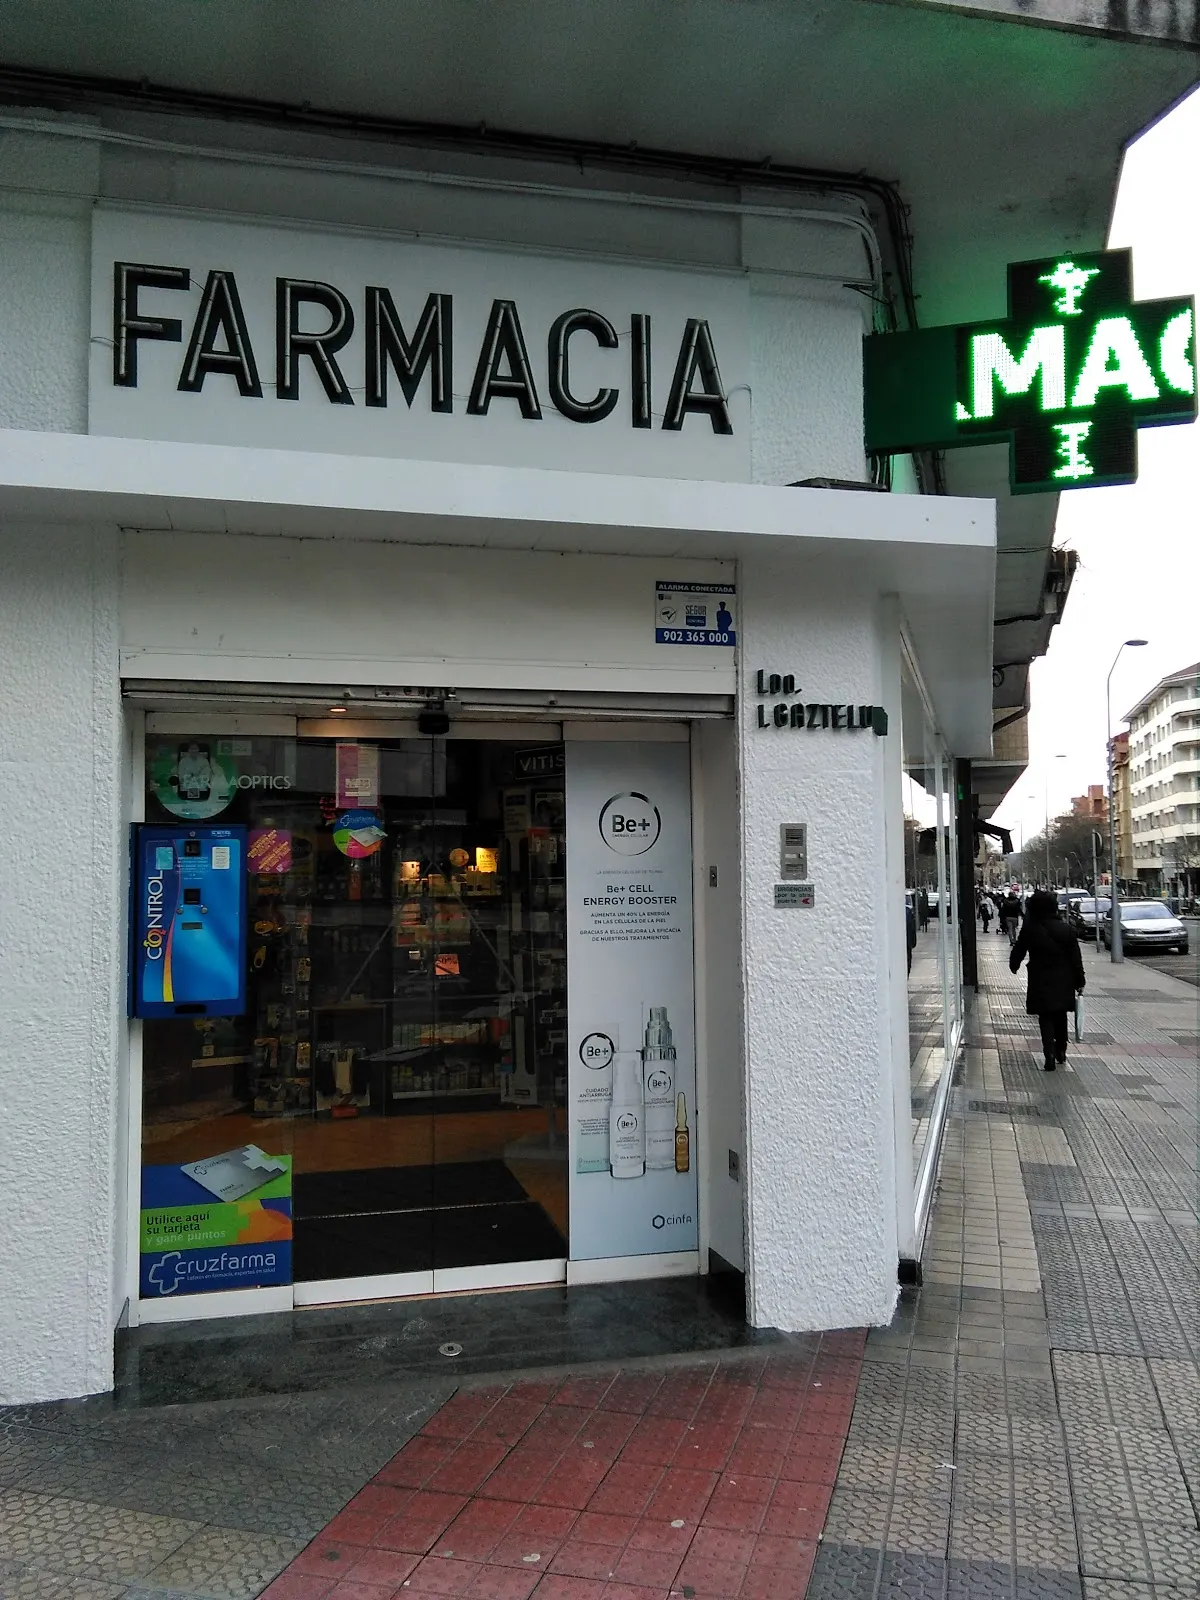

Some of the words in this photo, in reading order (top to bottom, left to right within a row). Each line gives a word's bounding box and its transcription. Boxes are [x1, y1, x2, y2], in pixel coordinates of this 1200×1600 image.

[113, 260, 734, 436] FARMACIA
[690, 585, 733, 593] CONECTADA
[685, 604, 707, 615] SEGUR
[663, 630, 683, 641] 902
[686, 631, 705, 642] 365
[708, 632, 728, 643] 000
[519, 753, 564, 771] VITIS
[612, 814, 650, 832] Be+
[606, 885, 626, 893] Be+
[628, 884, 654, 892] CELL
[583, 896, 625, 906] ENERGY
[628, 896, 677, 905] BOOSTER
[145, 869, 164, 960] CONTROL
[586, 1046, 609, 1057] Be+
[652, 1079, 667, 1087] Be+
[146, 1213, 182, 1226] Utilice
[185, 1211, 210, 1224] aquí
[146, 1225, 160, 1235] su
[163, 1222, 201, 1235] tarjeta
[145, 1236, 153, 1246] y
[155, 1233, 184, 1246] gane
[187, 1229, 226, 1243] puntos
[175, 1252, 276, 1275] cruzfarma
